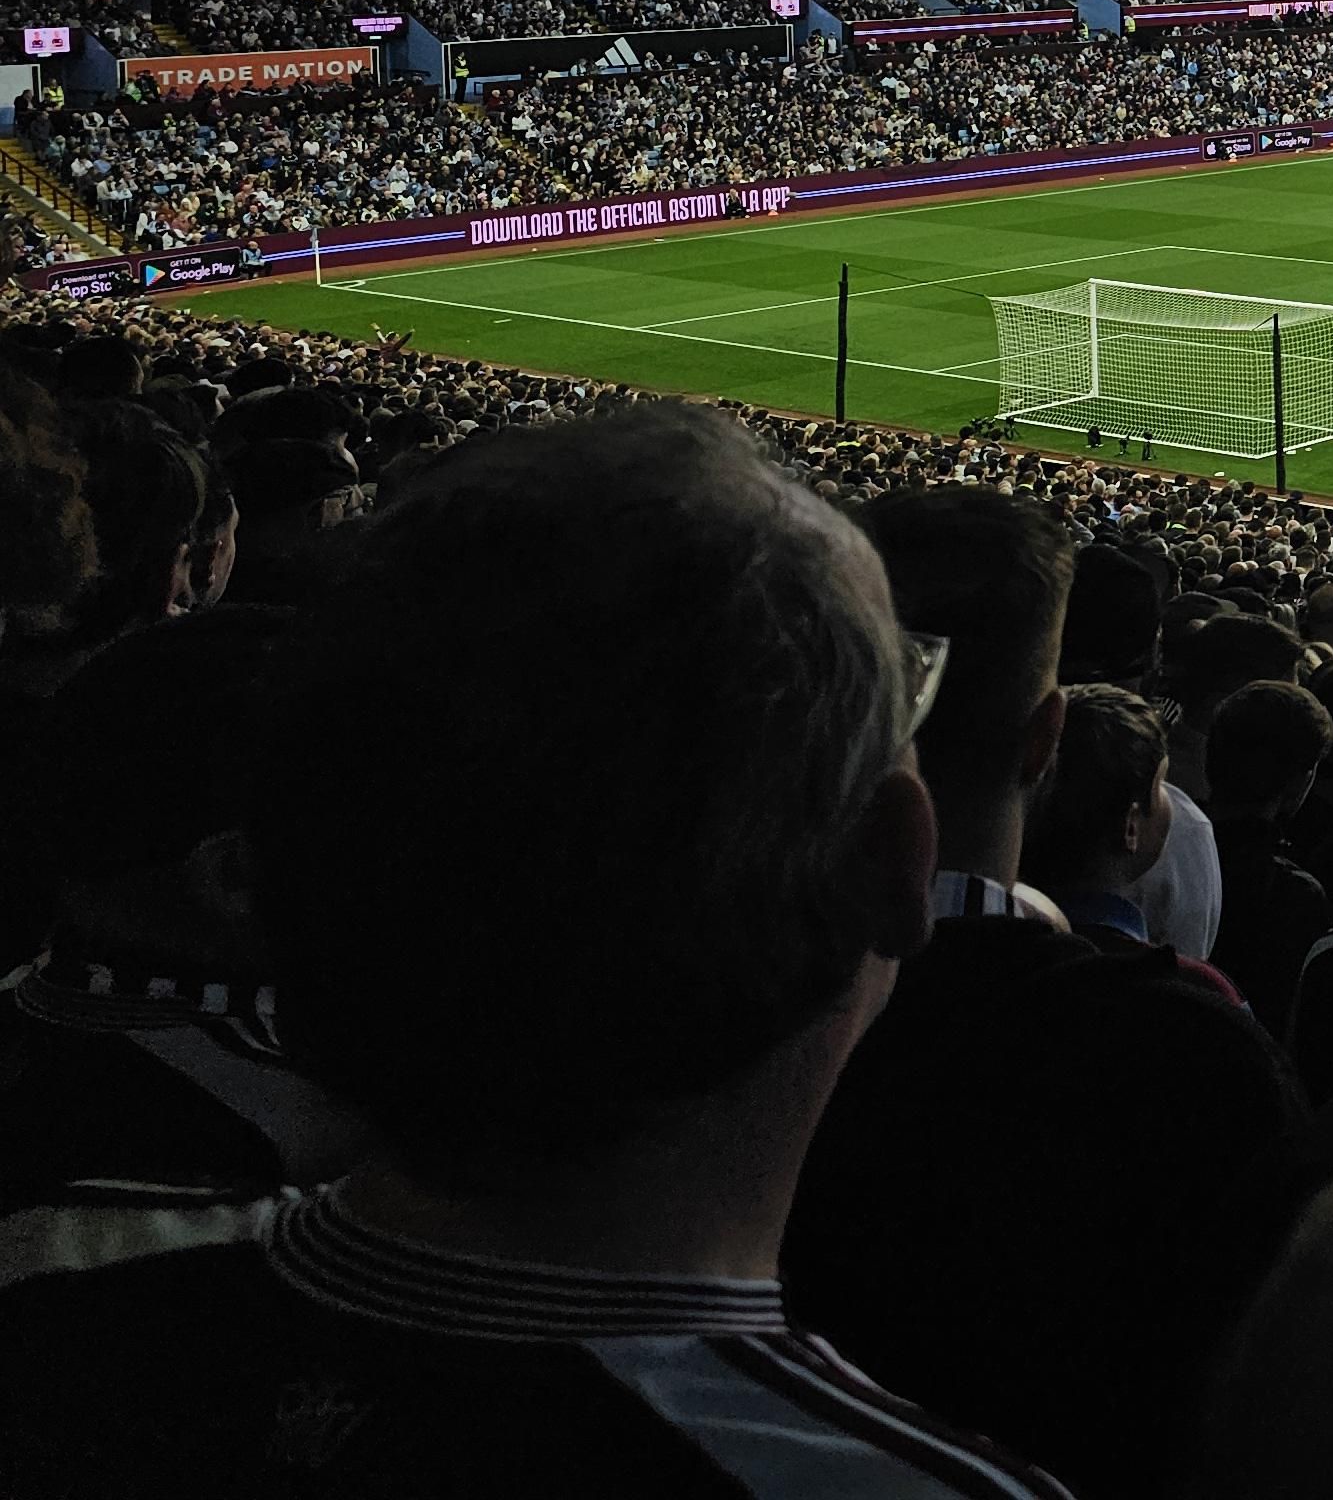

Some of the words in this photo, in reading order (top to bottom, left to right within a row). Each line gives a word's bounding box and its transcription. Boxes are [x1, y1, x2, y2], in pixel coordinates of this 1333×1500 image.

[158, 65, 252, 86] TRADE
[263, 59, 363, 80] NATION
[1275, 137, 1297, 148] Google
[1298, 136, 1310, 145] Play
[470, 212, 565, 245] DOWNLOAD
[566, 208, 597, 234] THE
[600, 200, 666, 230] OFFICIAL
[669, 194, 718, 222] ASTON
[170, 259, 183, 268] GET
[62, 274, 97, 285] Download
[170, 268, 211, 281] Google
[212, 263, 235, 277] Play
